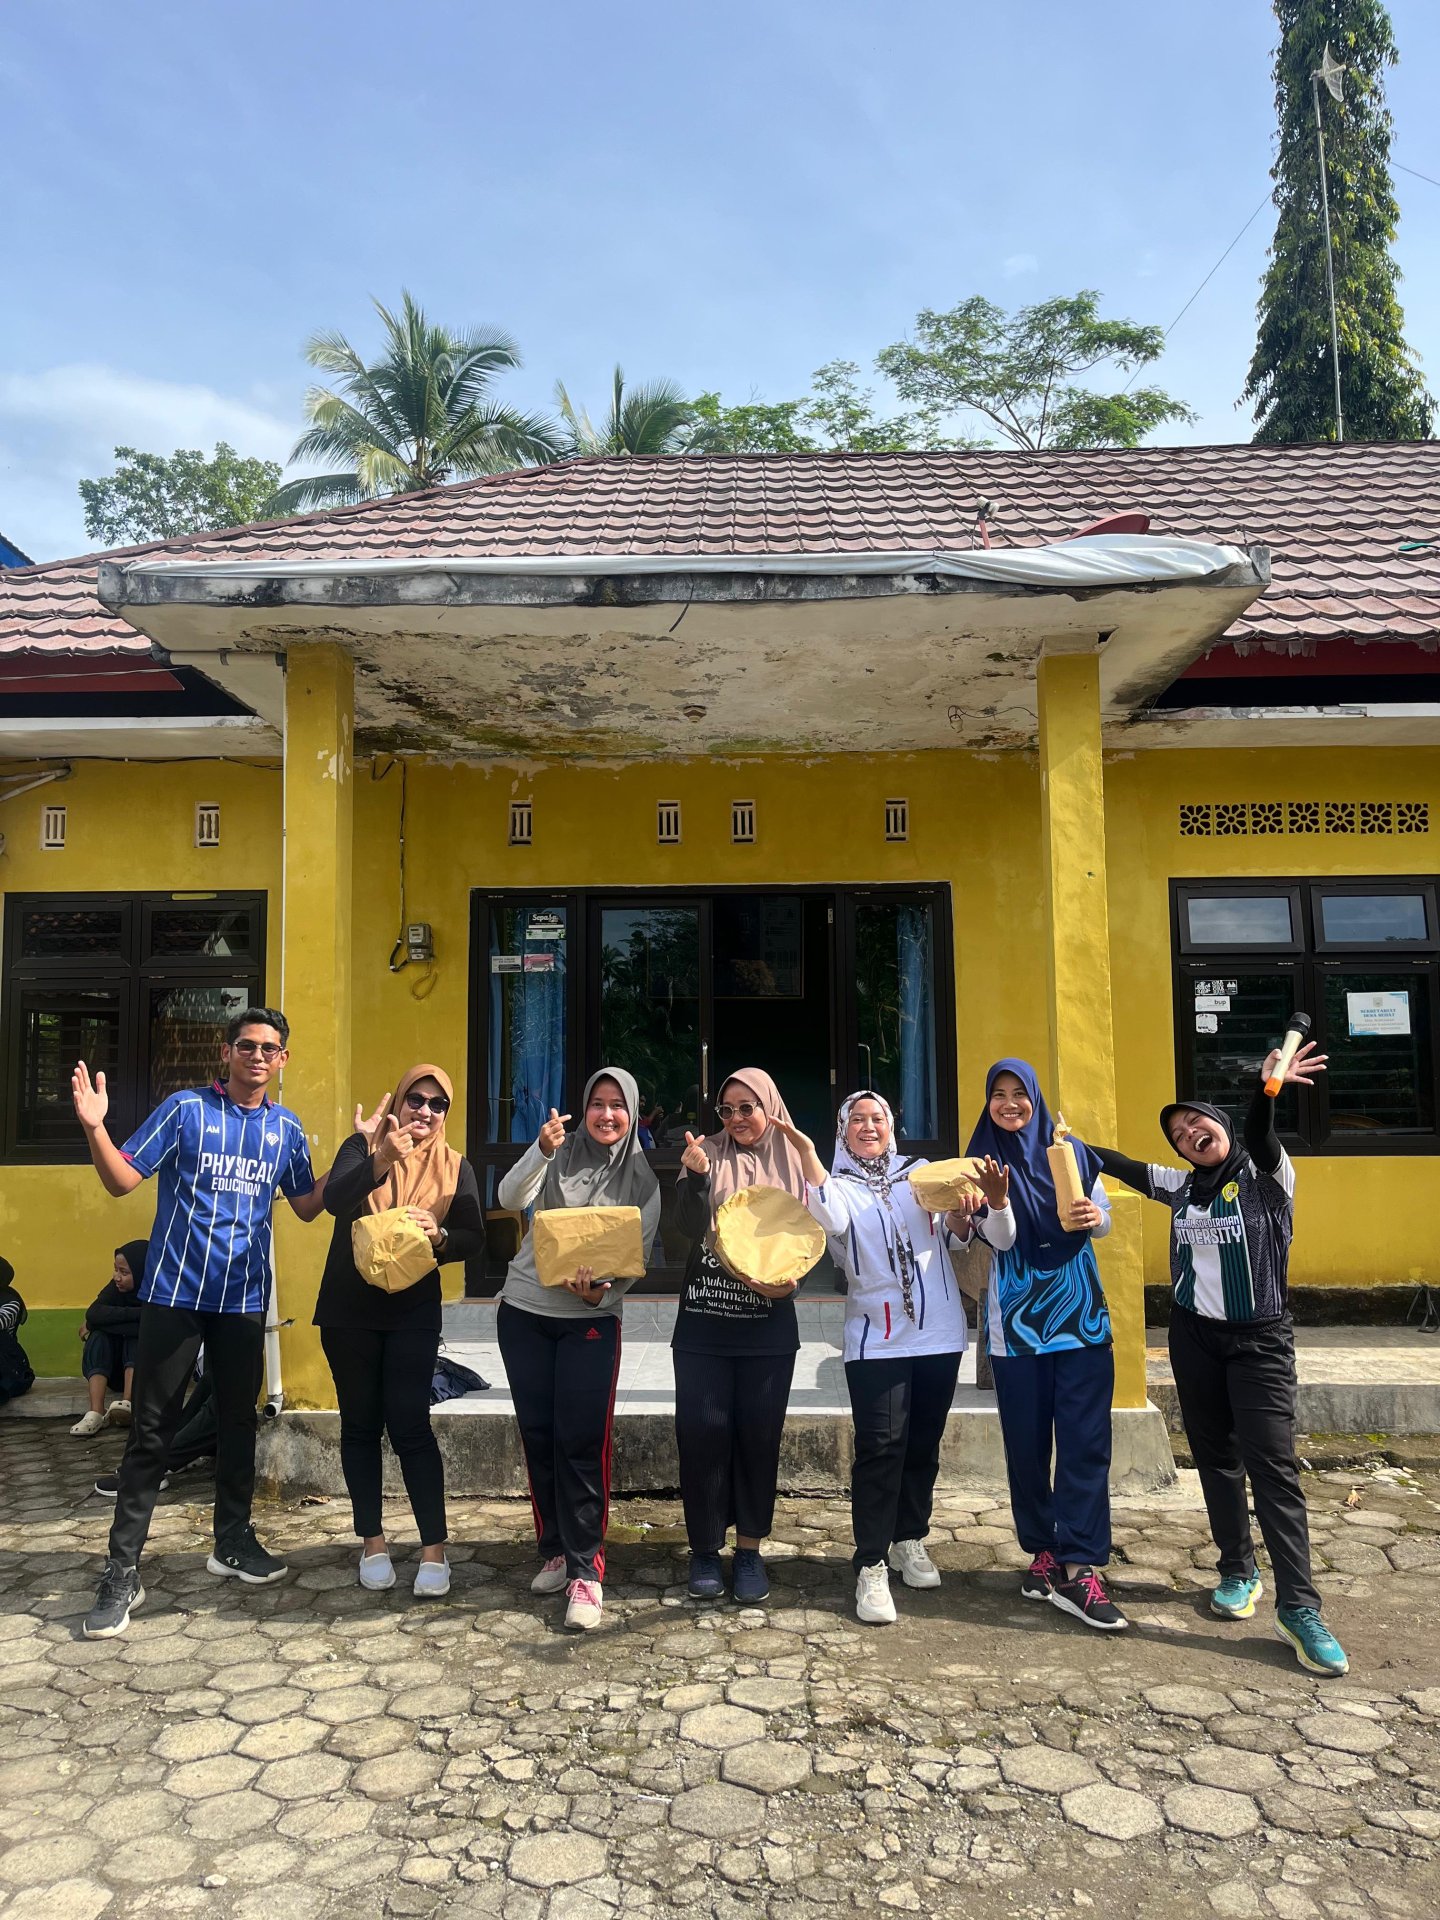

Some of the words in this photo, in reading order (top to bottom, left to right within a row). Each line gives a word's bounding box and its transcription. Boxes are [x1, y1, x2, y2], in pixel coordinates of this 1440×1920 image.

[205, 1125, 220, 1134] AM
[199, 1152, 273, 1184] PHYSICAL
[1175, 1225, 1242, 1245] NIVERSITY
[685, 1284, 773, 1307] Muhammadiyah
